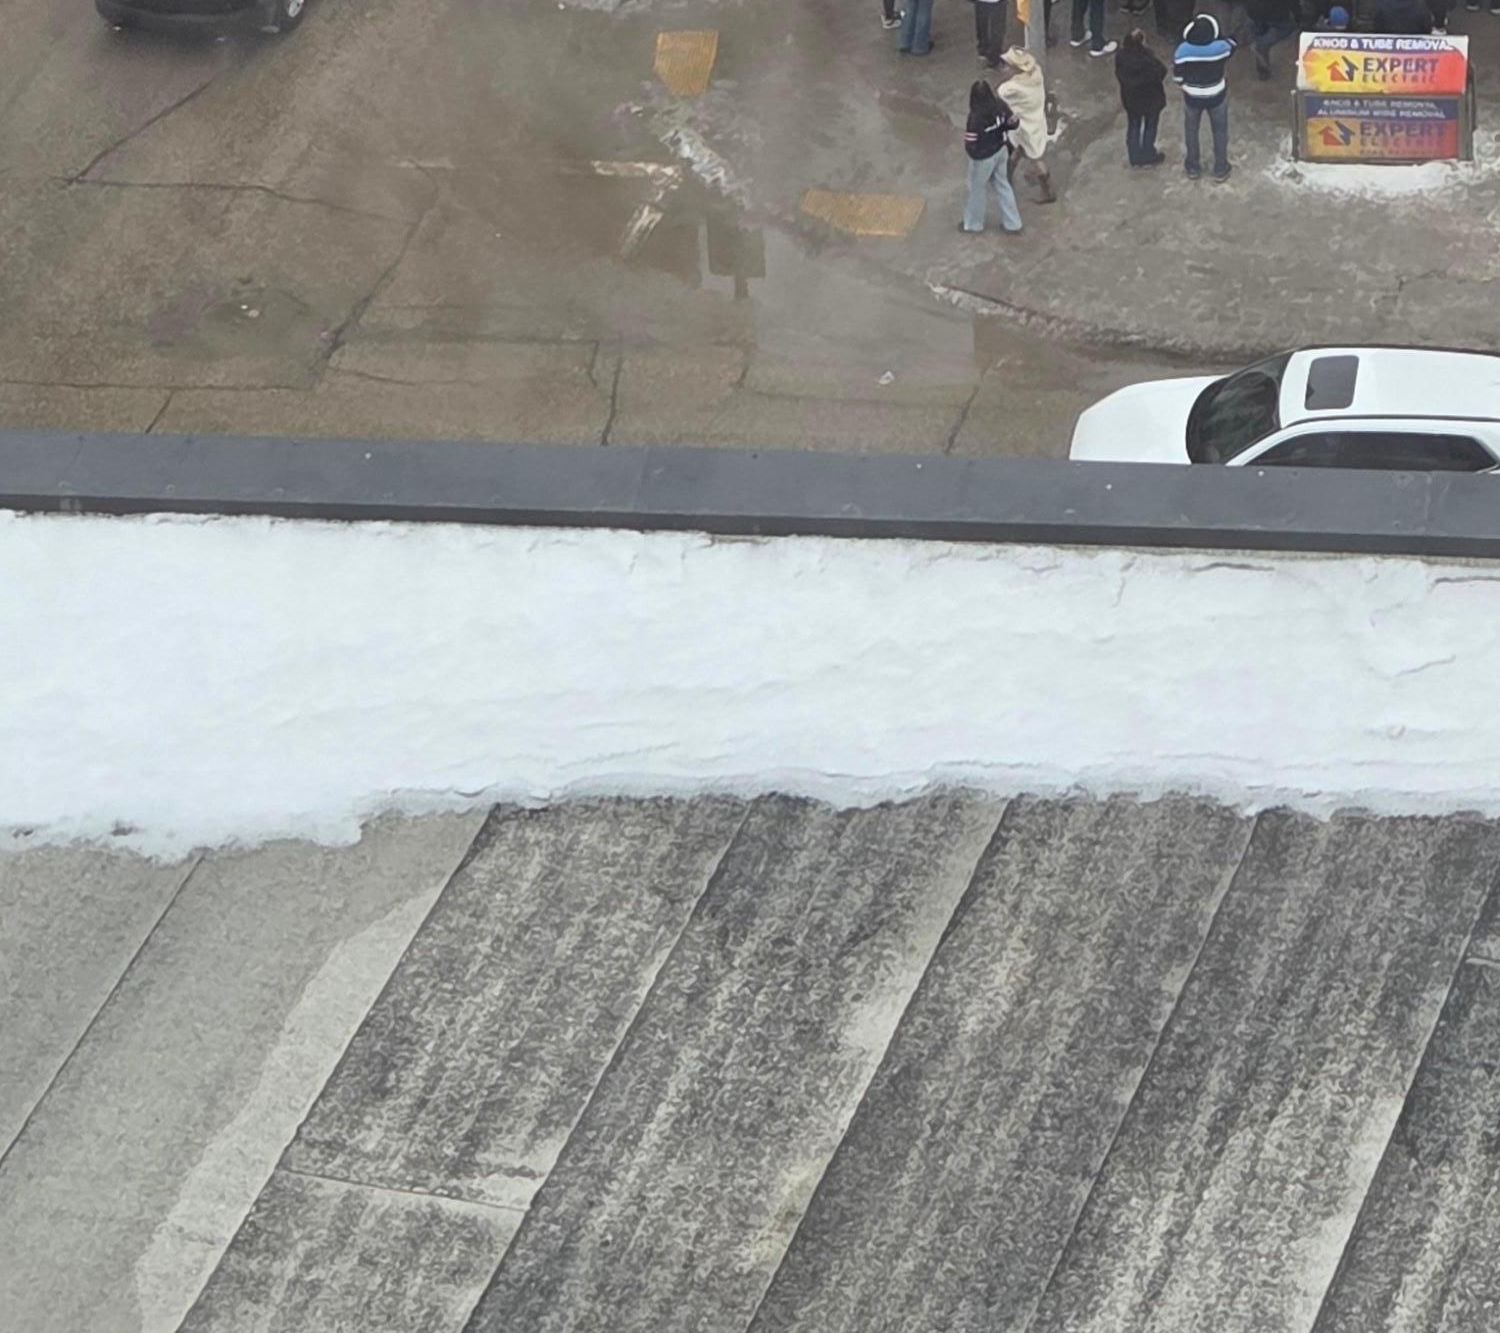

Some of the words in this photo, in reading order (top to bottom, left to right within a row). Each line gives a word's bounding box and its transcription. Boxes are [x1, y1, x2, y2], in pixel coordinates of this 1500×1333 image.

[1362, 38, 1393, 49] TUBE
[1396, 39, 1454, 51] REMOVAL
[1363, 57, 1440, 73] EXPERT
[1362, 74, 1436, 83] ELECTRIC
[1360, 121, 1446, 136] EXPERT
